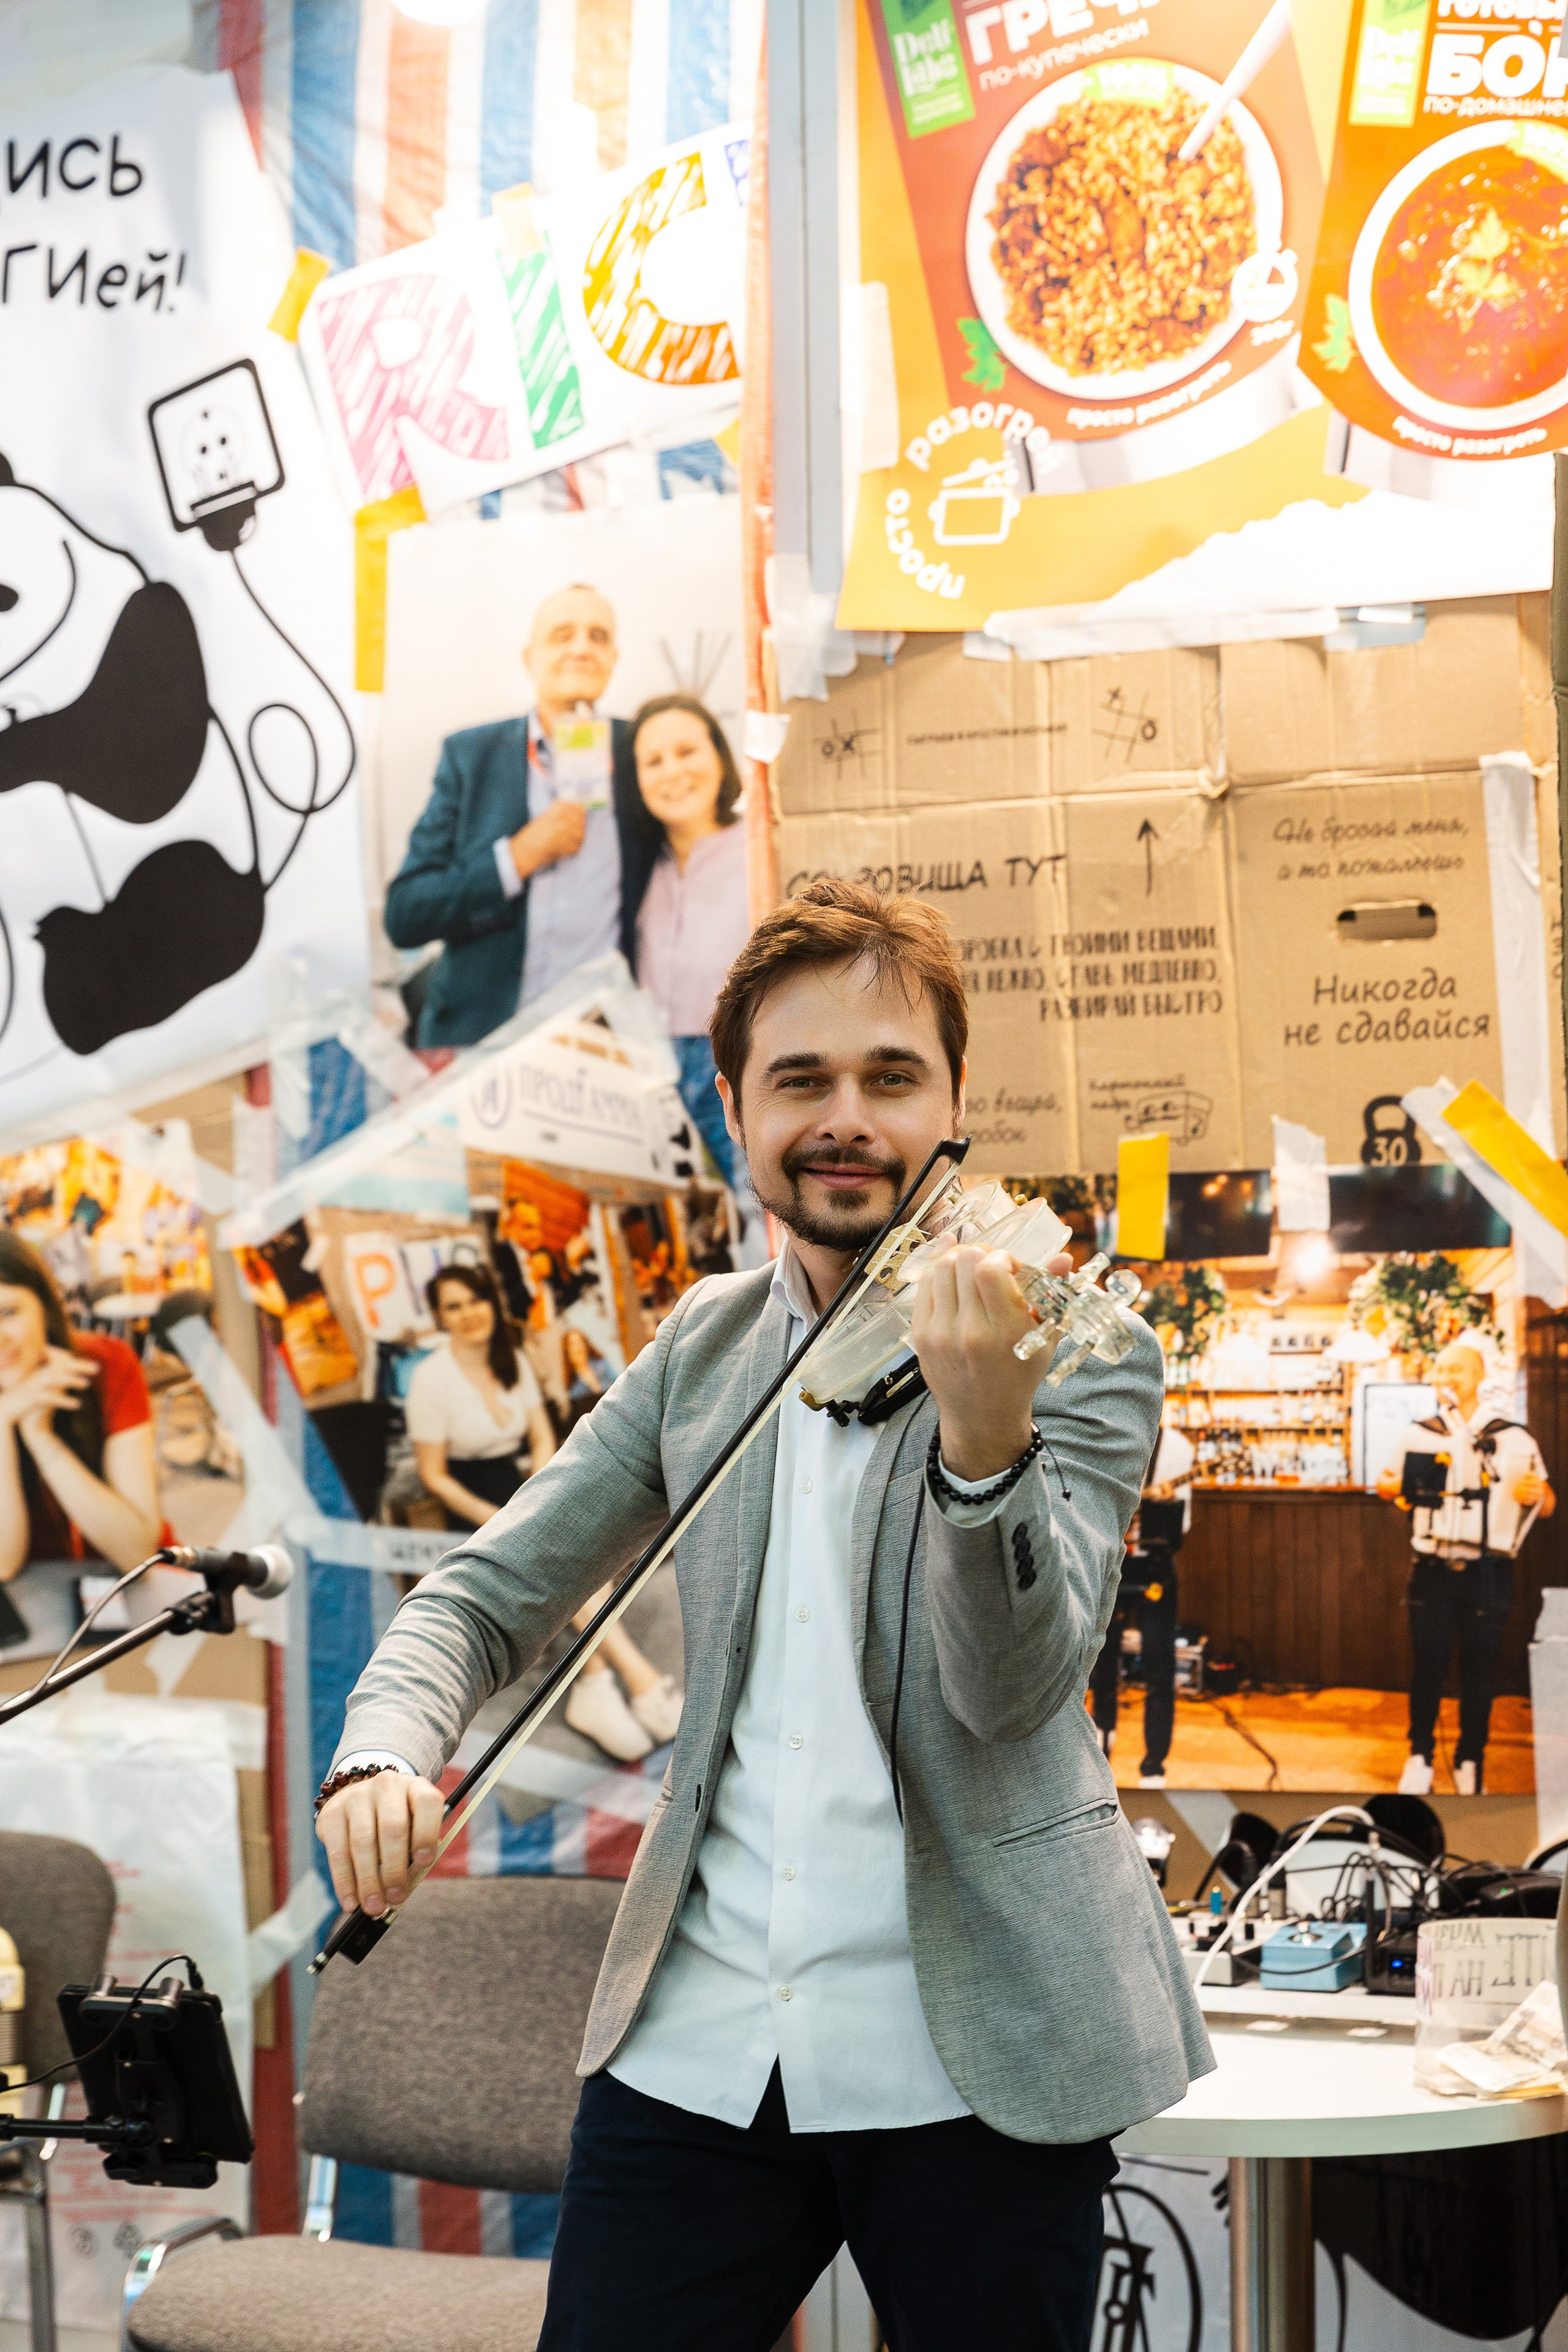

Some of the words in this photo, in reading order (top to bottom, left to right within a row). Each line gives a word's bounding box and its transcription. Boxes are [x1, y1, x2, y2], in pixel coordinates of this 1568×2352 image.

[1006, 853, 1068, 887] ТУТ
[1313, 966, 1457, 1006] Никогда
[1283, 1022, 1322, 1046] не
[1336, 1006, 1490, 1042] сдавайся
[1370, 1136, 1408, 1167] 30
